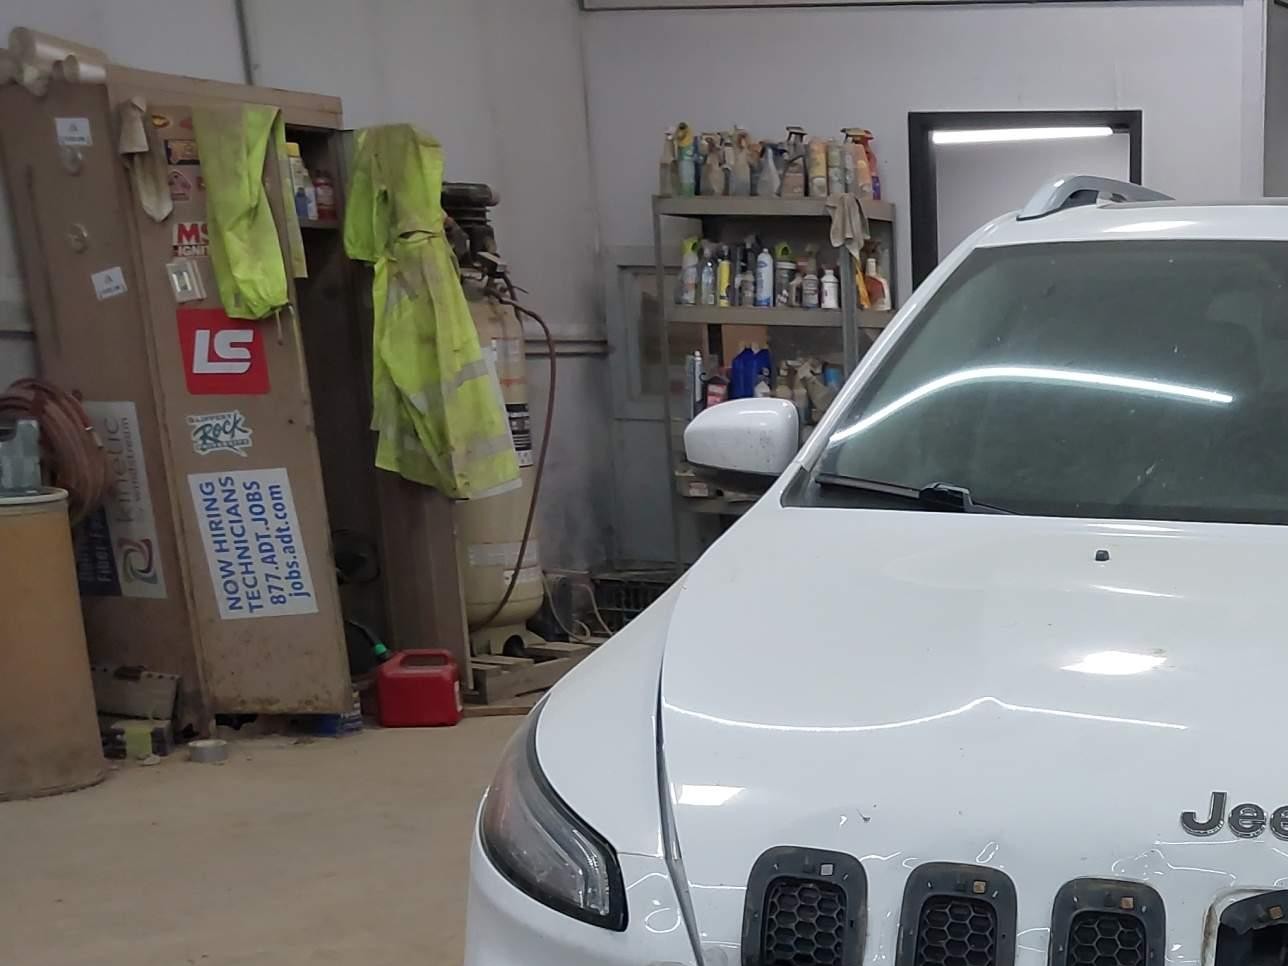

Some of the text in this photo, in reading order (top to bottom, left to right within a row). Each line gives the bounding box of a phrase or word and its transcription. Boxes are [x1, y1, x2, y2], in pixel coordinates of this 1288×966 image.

[177, 223, 209, 244] MS
[192, 329, 254, 374] LS
[199, 481, 230, 553] HIRING
[218, 476, 264, 614] TECHNICIANS
[243, 480, 288, 605] 877.ADT.JOBS
[268, 484, 312, 598] jobs.adt.com
[217, 559, 243, 611] NOW
